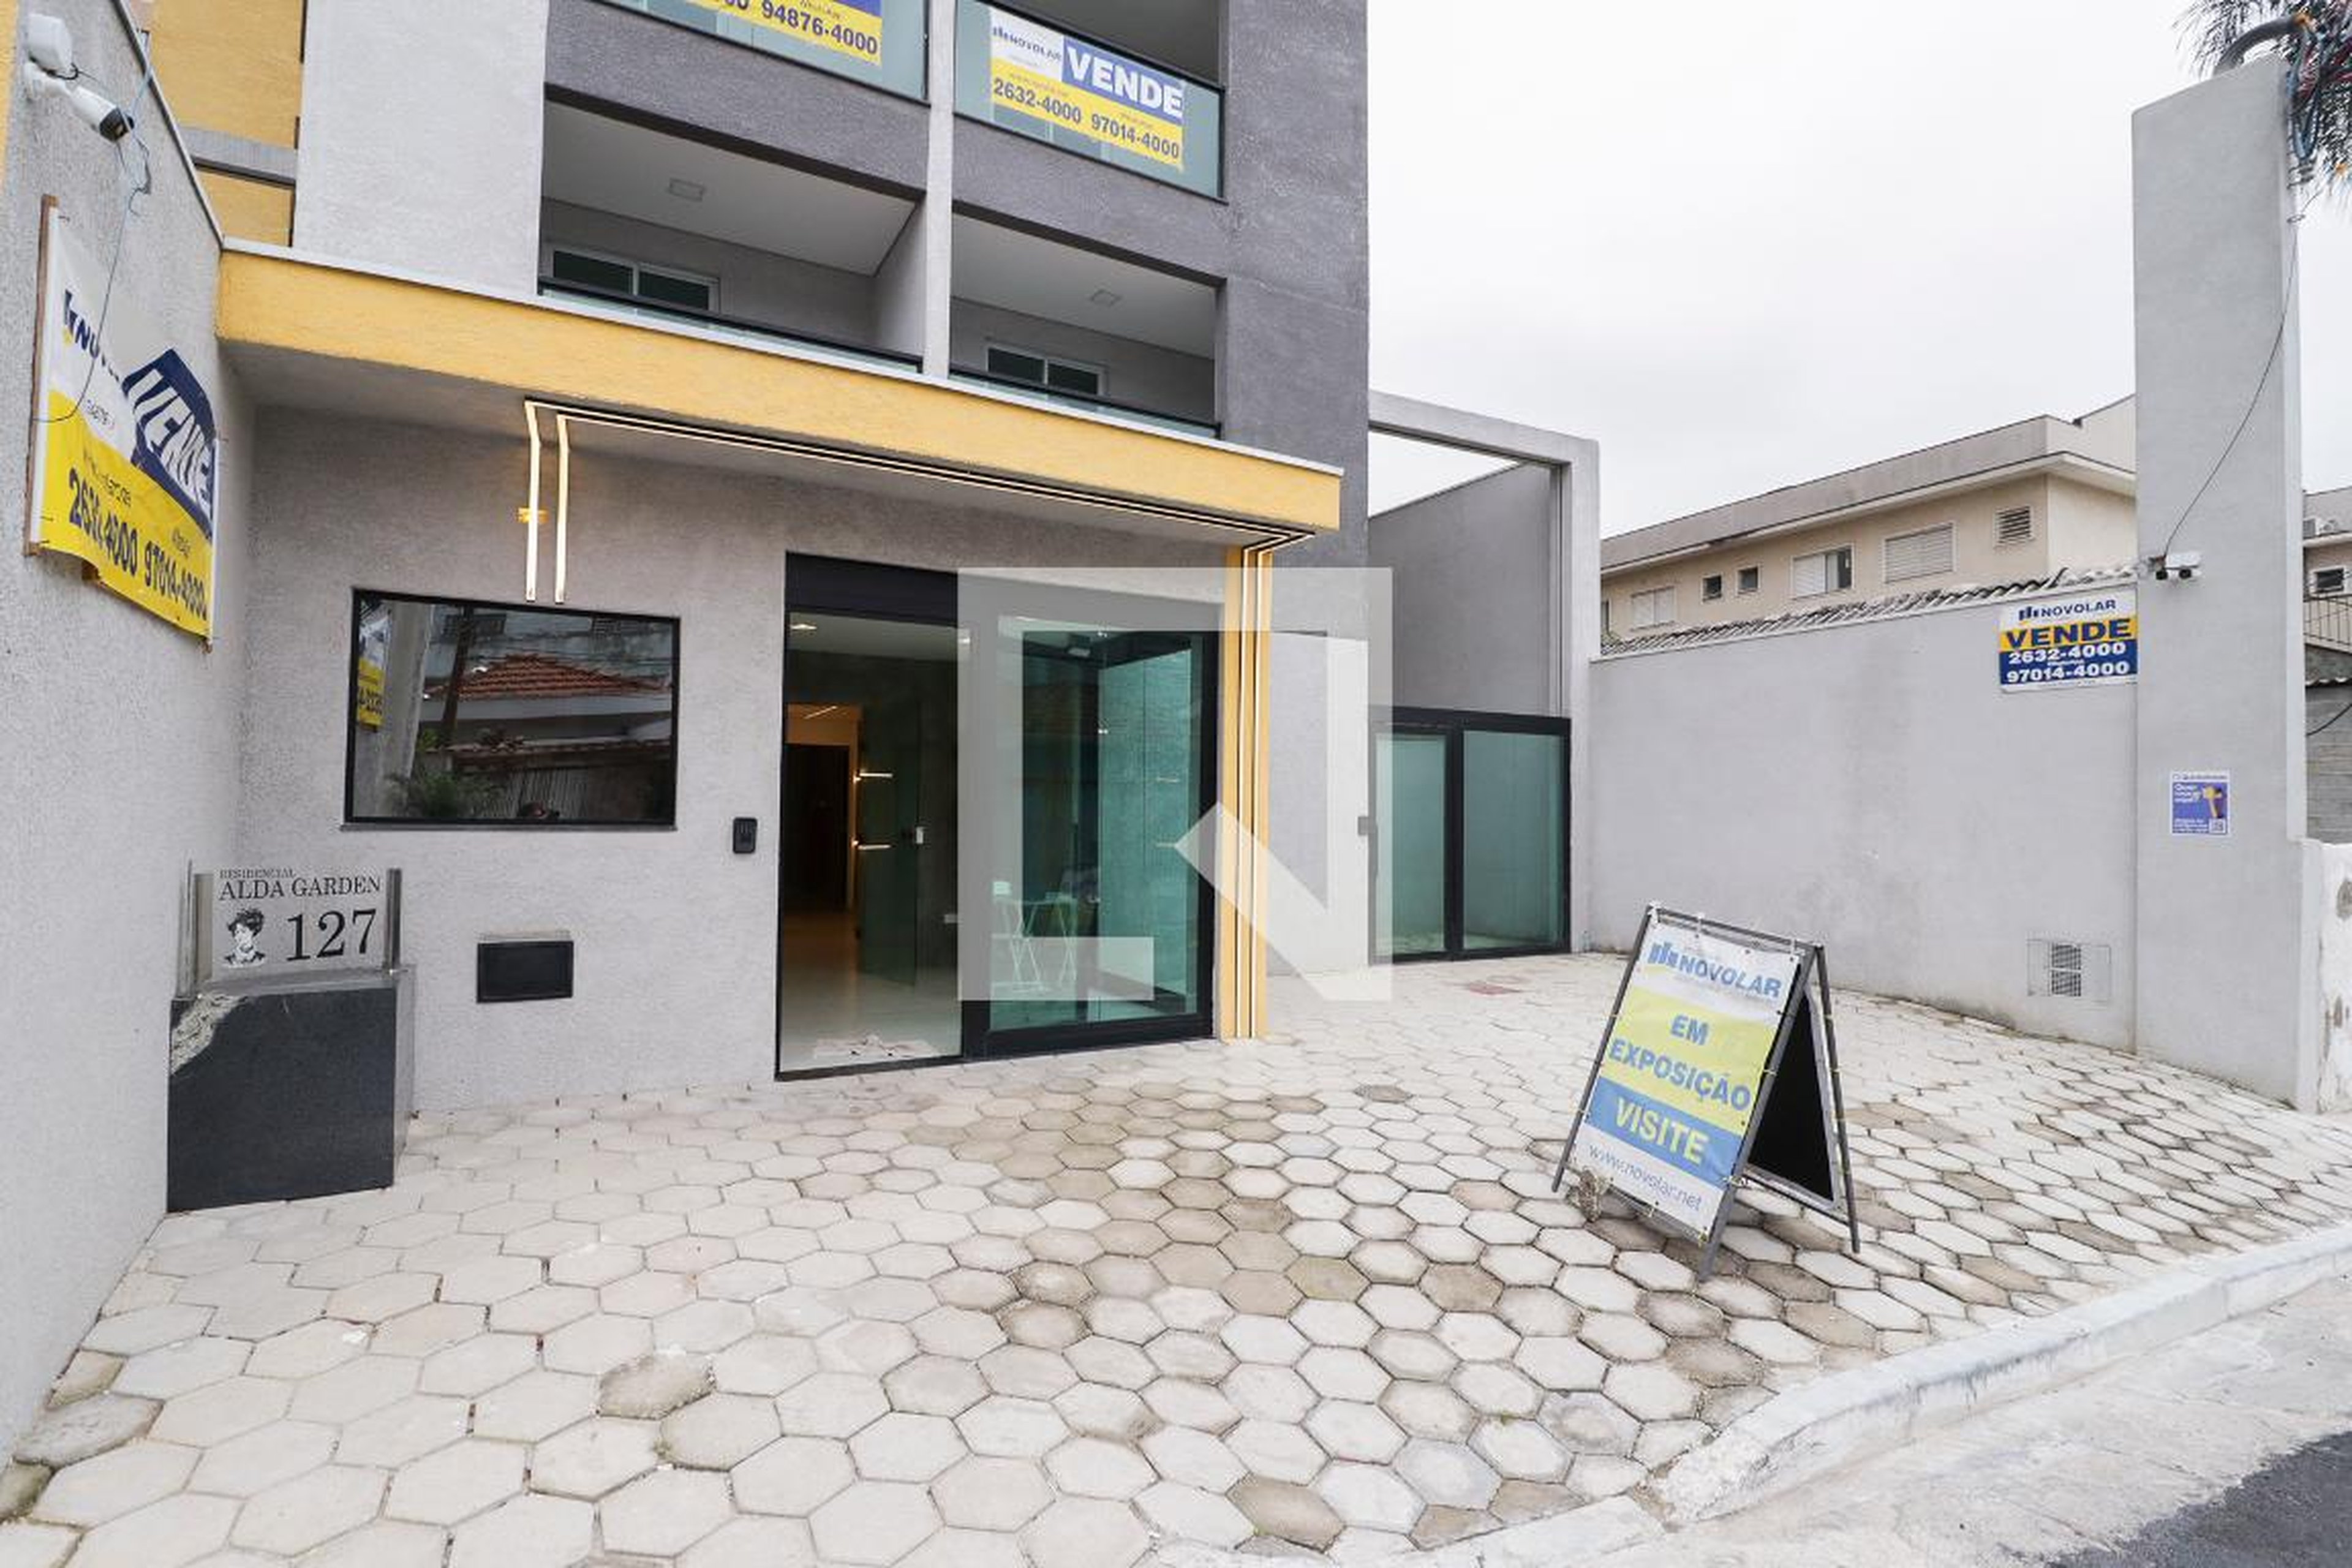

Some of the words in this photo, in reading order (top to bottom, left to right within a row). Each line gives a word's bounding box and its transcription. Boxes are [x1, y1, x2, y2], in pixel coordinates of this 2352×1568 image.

[1066, 47, 1185, 118] VENDE
[2041, 600, 2116, 617] NOVOLAR
[2006, 618, 2132, 648] VENDE
[2009, 642, 2127, 665] 2632-4000
[2007, 661, 2130, 683] 97014-4000
[219, 879, 285, 901] ALDA
[292, 876, 380, 897] GARDEN
[287, 908, 377, 962] 127
[1679, 956, 1782, 998] NOVOLAR
[1670, 1014, 1709, 1046] EM
[1616, 1097, 1709, 1164] VISITE
